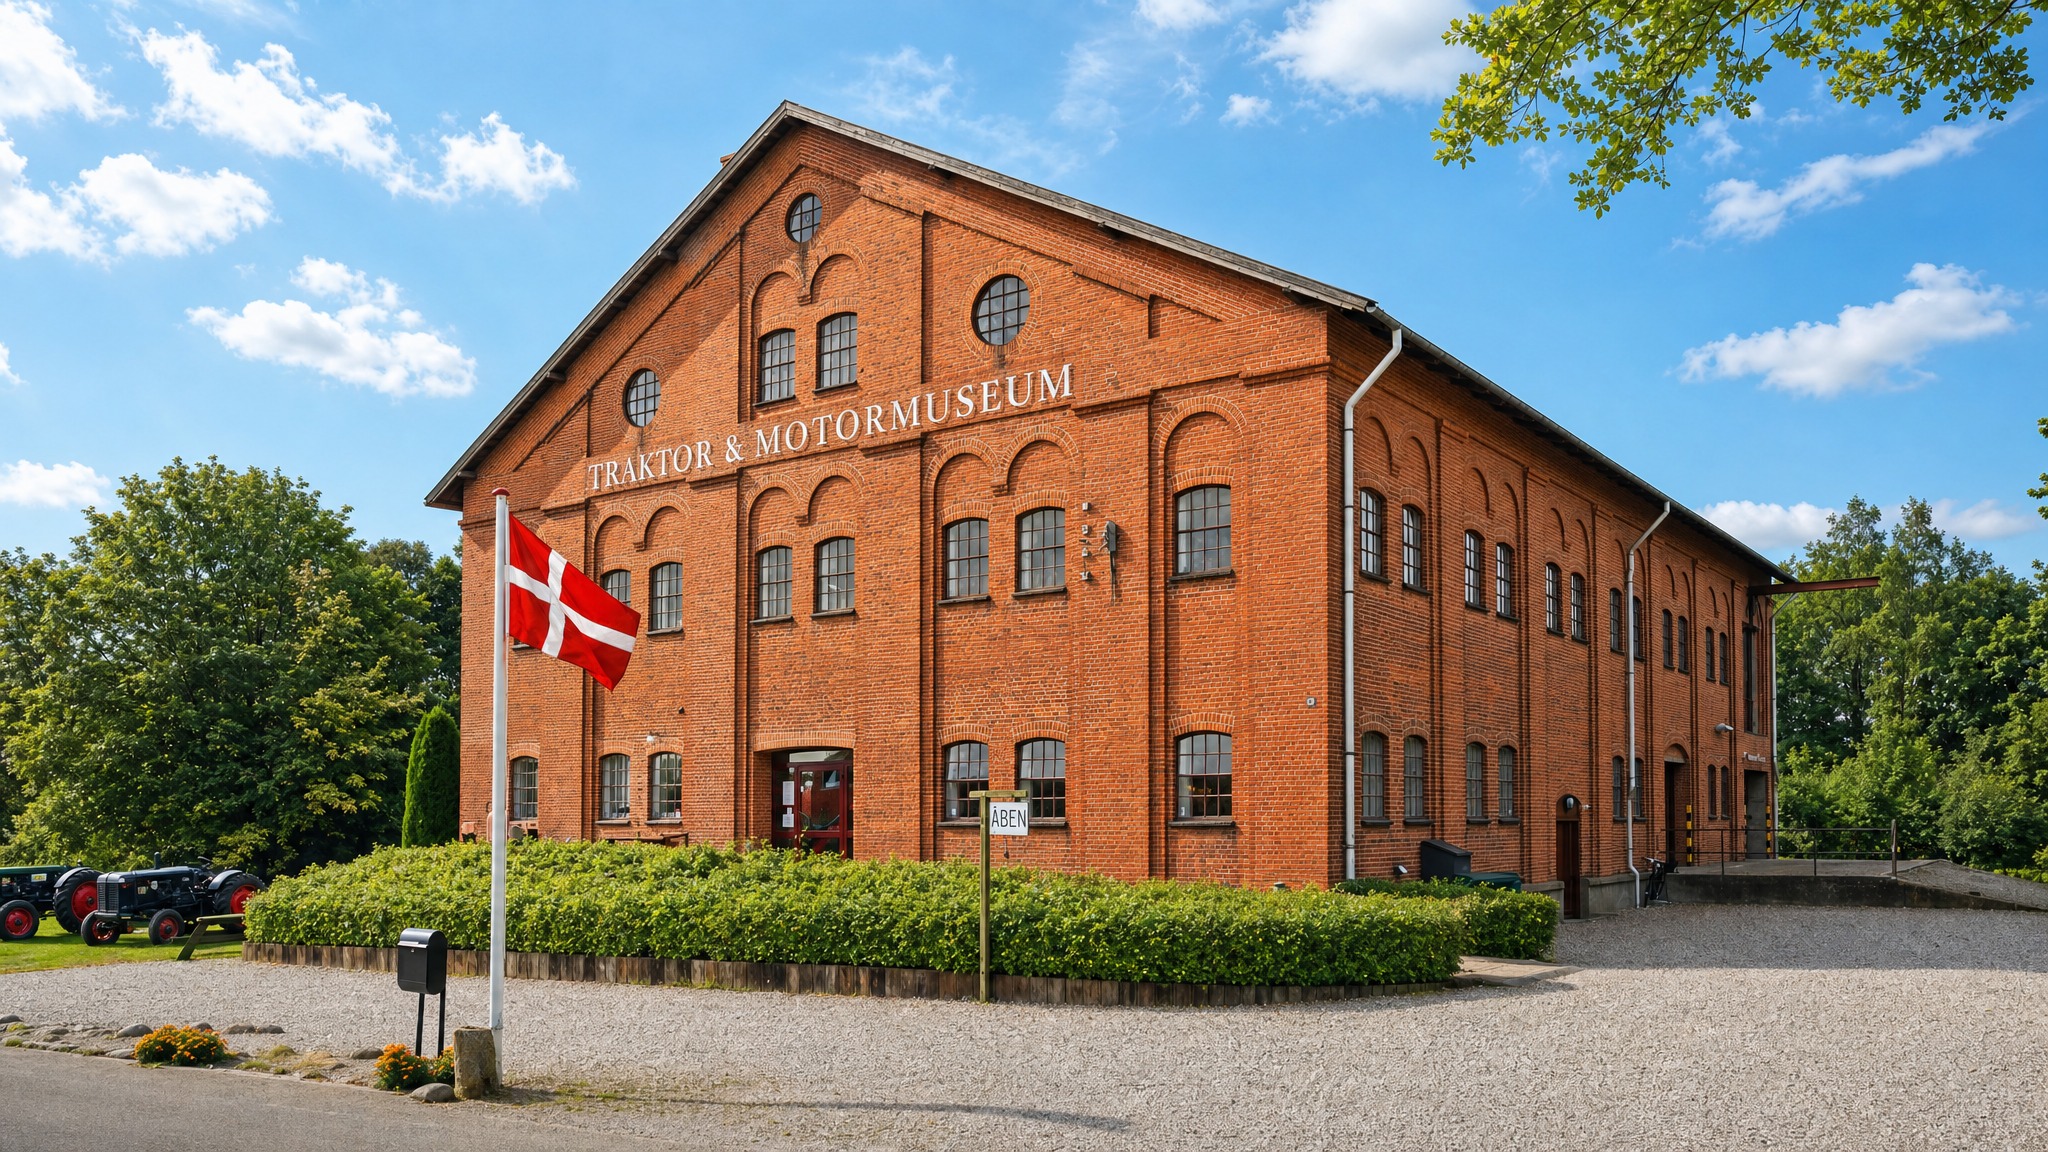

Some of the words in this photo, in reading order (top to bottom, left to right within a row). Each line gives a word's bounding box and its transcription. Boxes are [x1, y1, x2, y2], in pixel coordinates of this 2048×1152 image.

[588, 441, 713, 490] TRAKTOR
[725, 435, 744, 463] &
[756, 364, 1073, 458] MOTORMUSEUM
[991, 806, 1026, 827] ÅBEN
